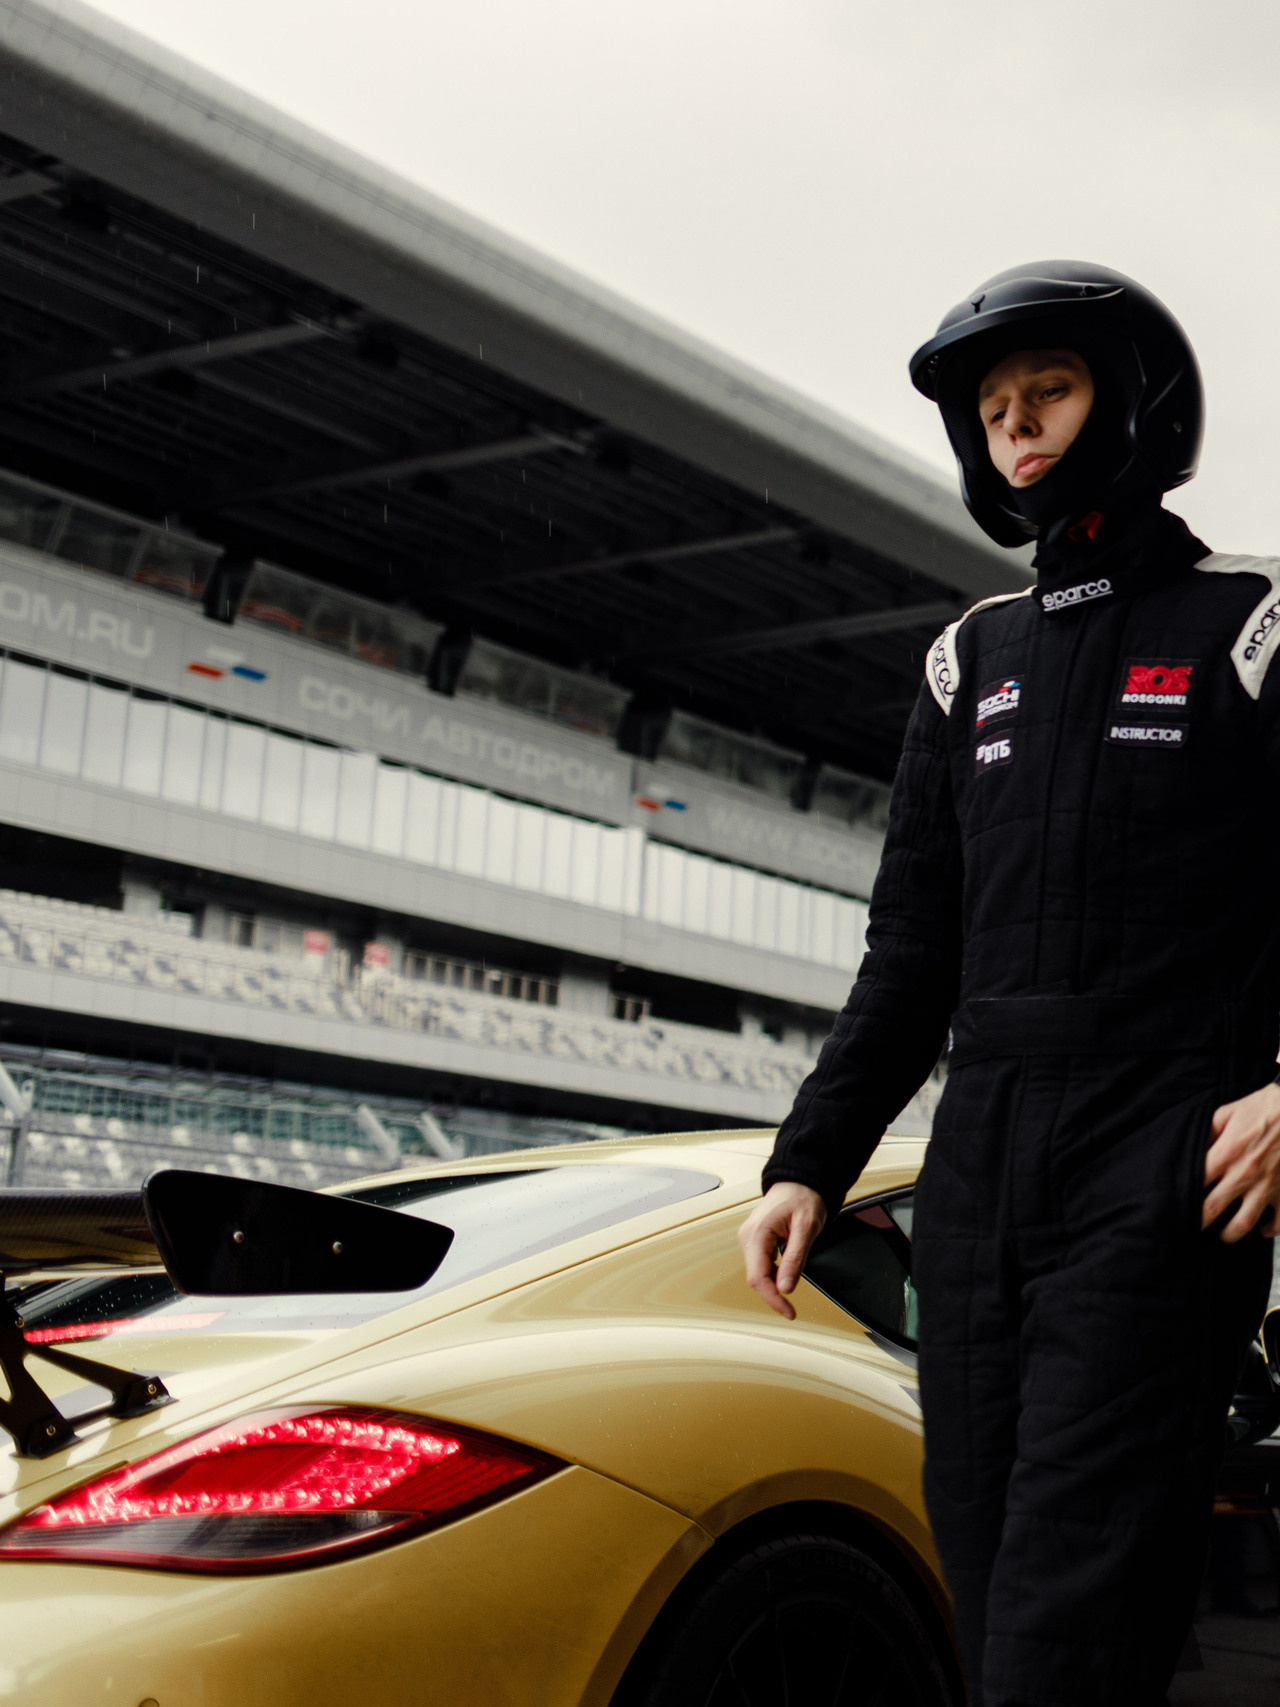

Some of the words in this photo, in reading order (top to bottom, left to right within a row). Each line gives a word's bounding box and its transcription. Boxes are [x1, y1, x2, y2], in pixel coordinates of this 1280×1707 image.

[1124, 665, 1193, 694] ROS
[977, 689, 1020, 714] SOCHI
[1121, 693, 1187, 705] ROSGONKI
[298, 676, 410, 735] СОЧИ
[421, 714, 616, 798] АВТОДРОМ
[1110, 726, 1183, 742] INSTRUCTOR
[984, 739, 1011, 764] ВТБ
